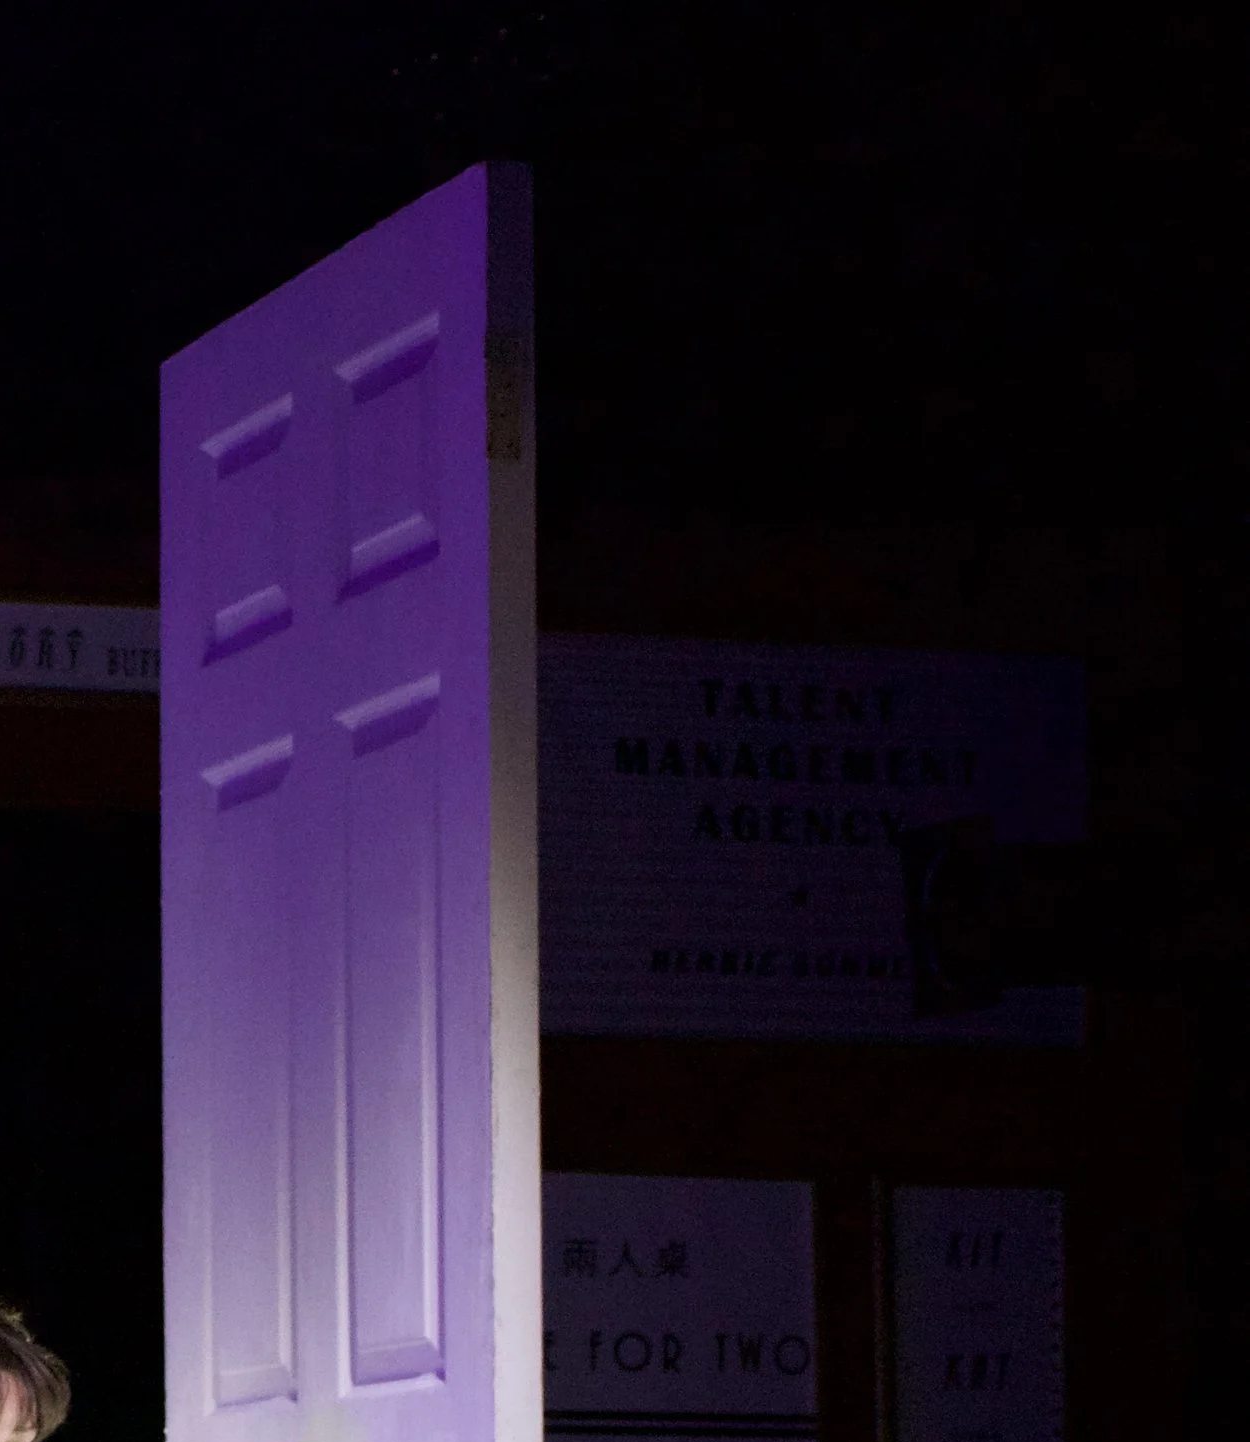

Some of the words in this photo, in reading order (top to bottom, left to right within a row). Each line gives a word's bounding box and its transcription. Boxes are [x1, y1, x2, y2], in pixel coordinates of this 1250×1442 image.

[698, 680, 894, 722] TALENT
[615, 738, 980, 787] MANAGEMENT
[693, 804, 906, 844] AGENCY
[590, 1331, 682, 1373] FOR
[715, 1332, 810, 1376] TWO
